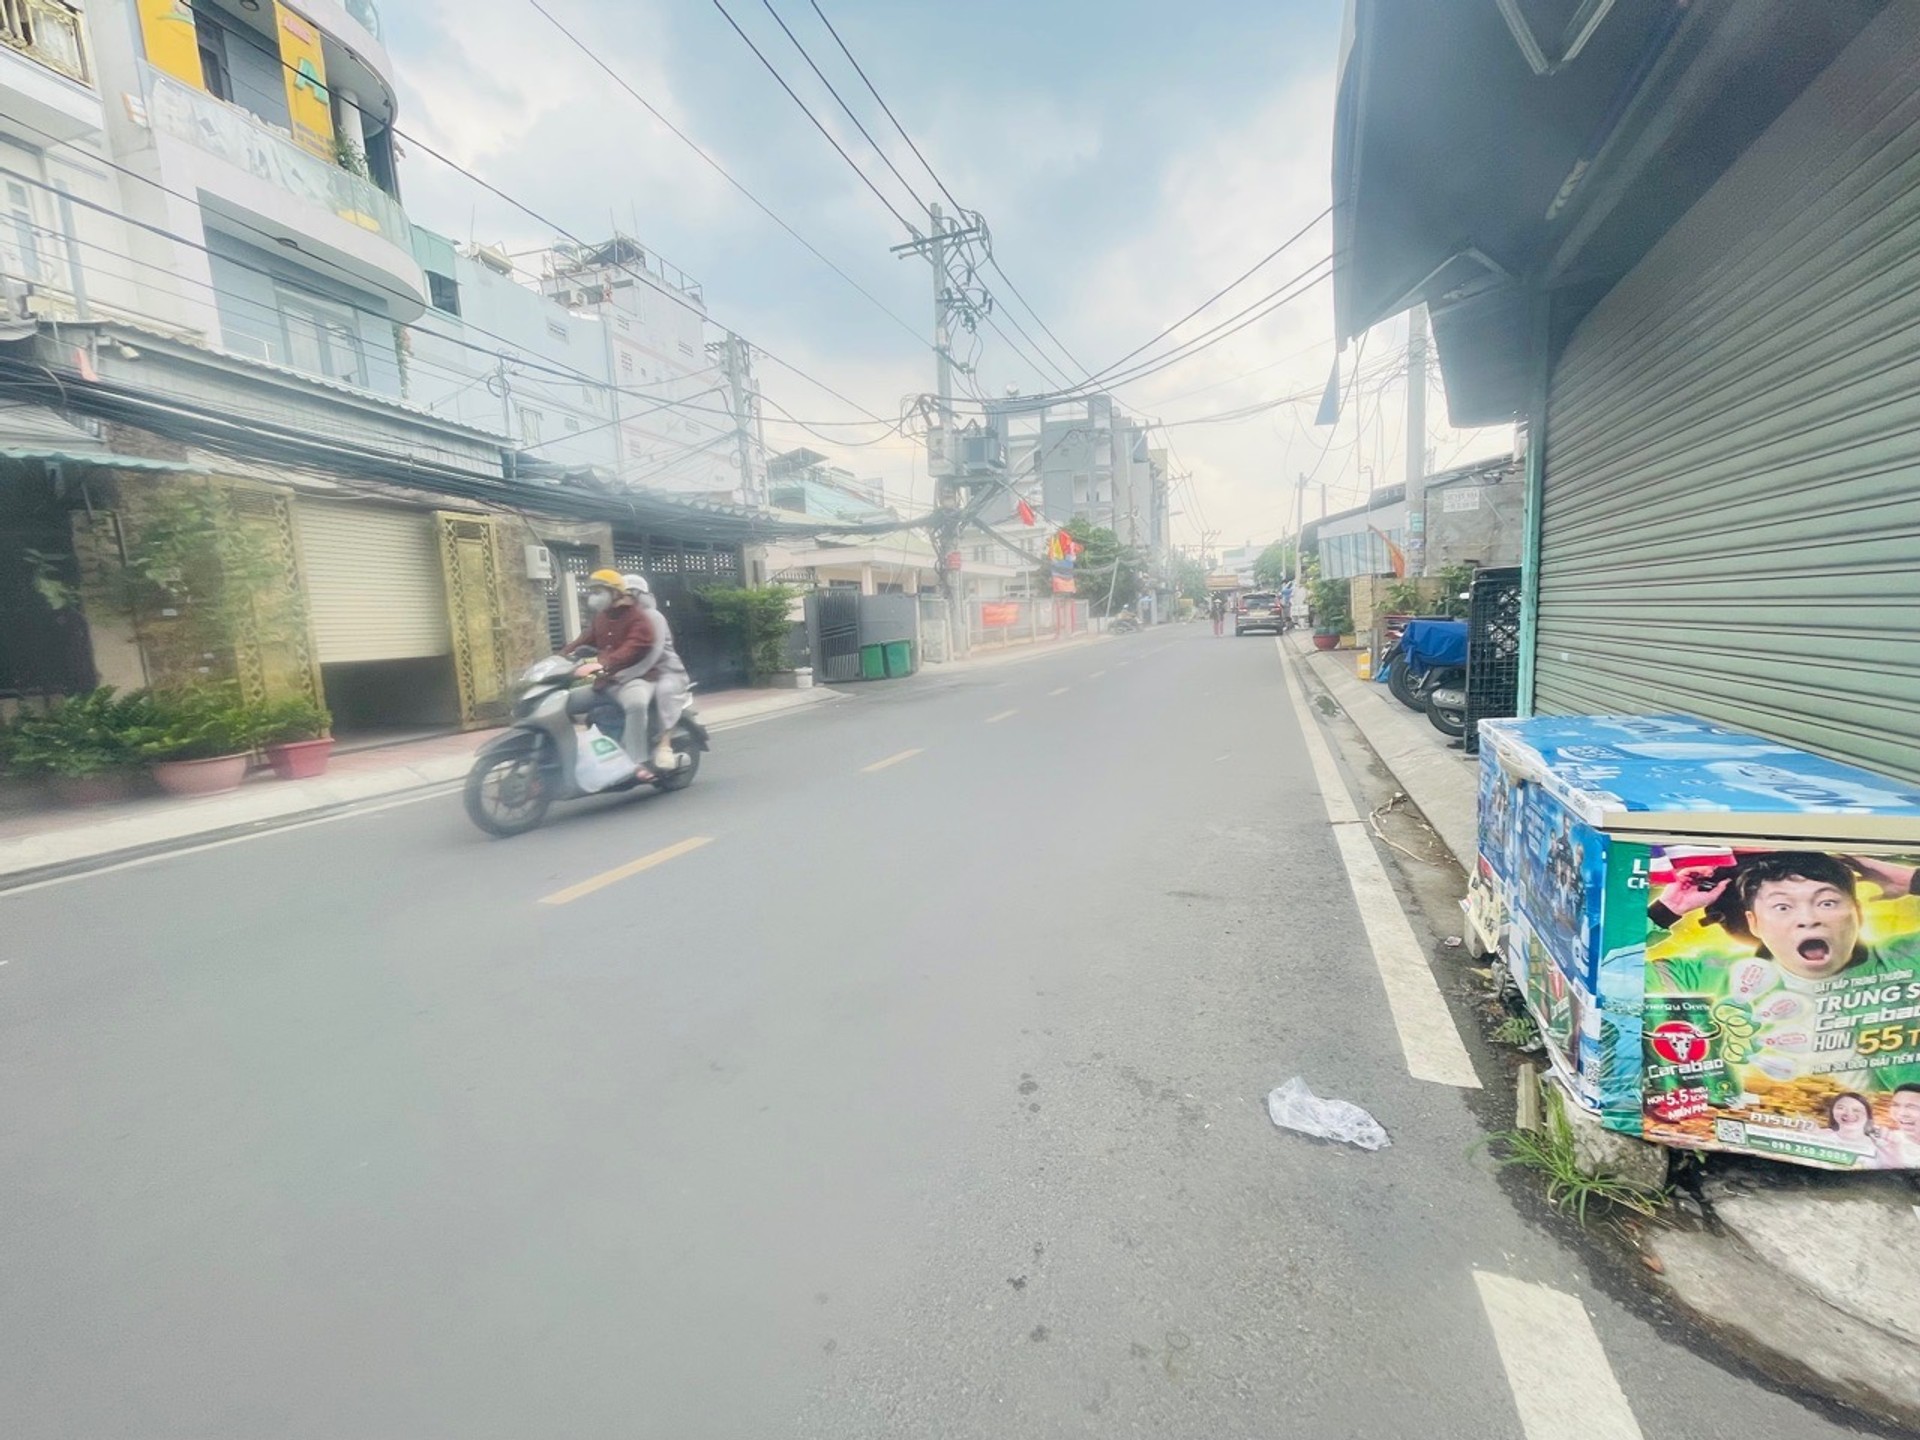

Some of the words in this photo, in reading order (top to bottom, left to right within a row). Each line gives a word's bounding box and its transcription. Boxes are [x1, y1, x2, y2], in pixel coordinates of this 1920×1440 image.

[294, 57, 329, 106] A
[1856, 1024, 1904, 1055] 55
[1647, 1058, 1724, 1079] Carabao
[1666, 1088, 1689, 1106] 5.5
